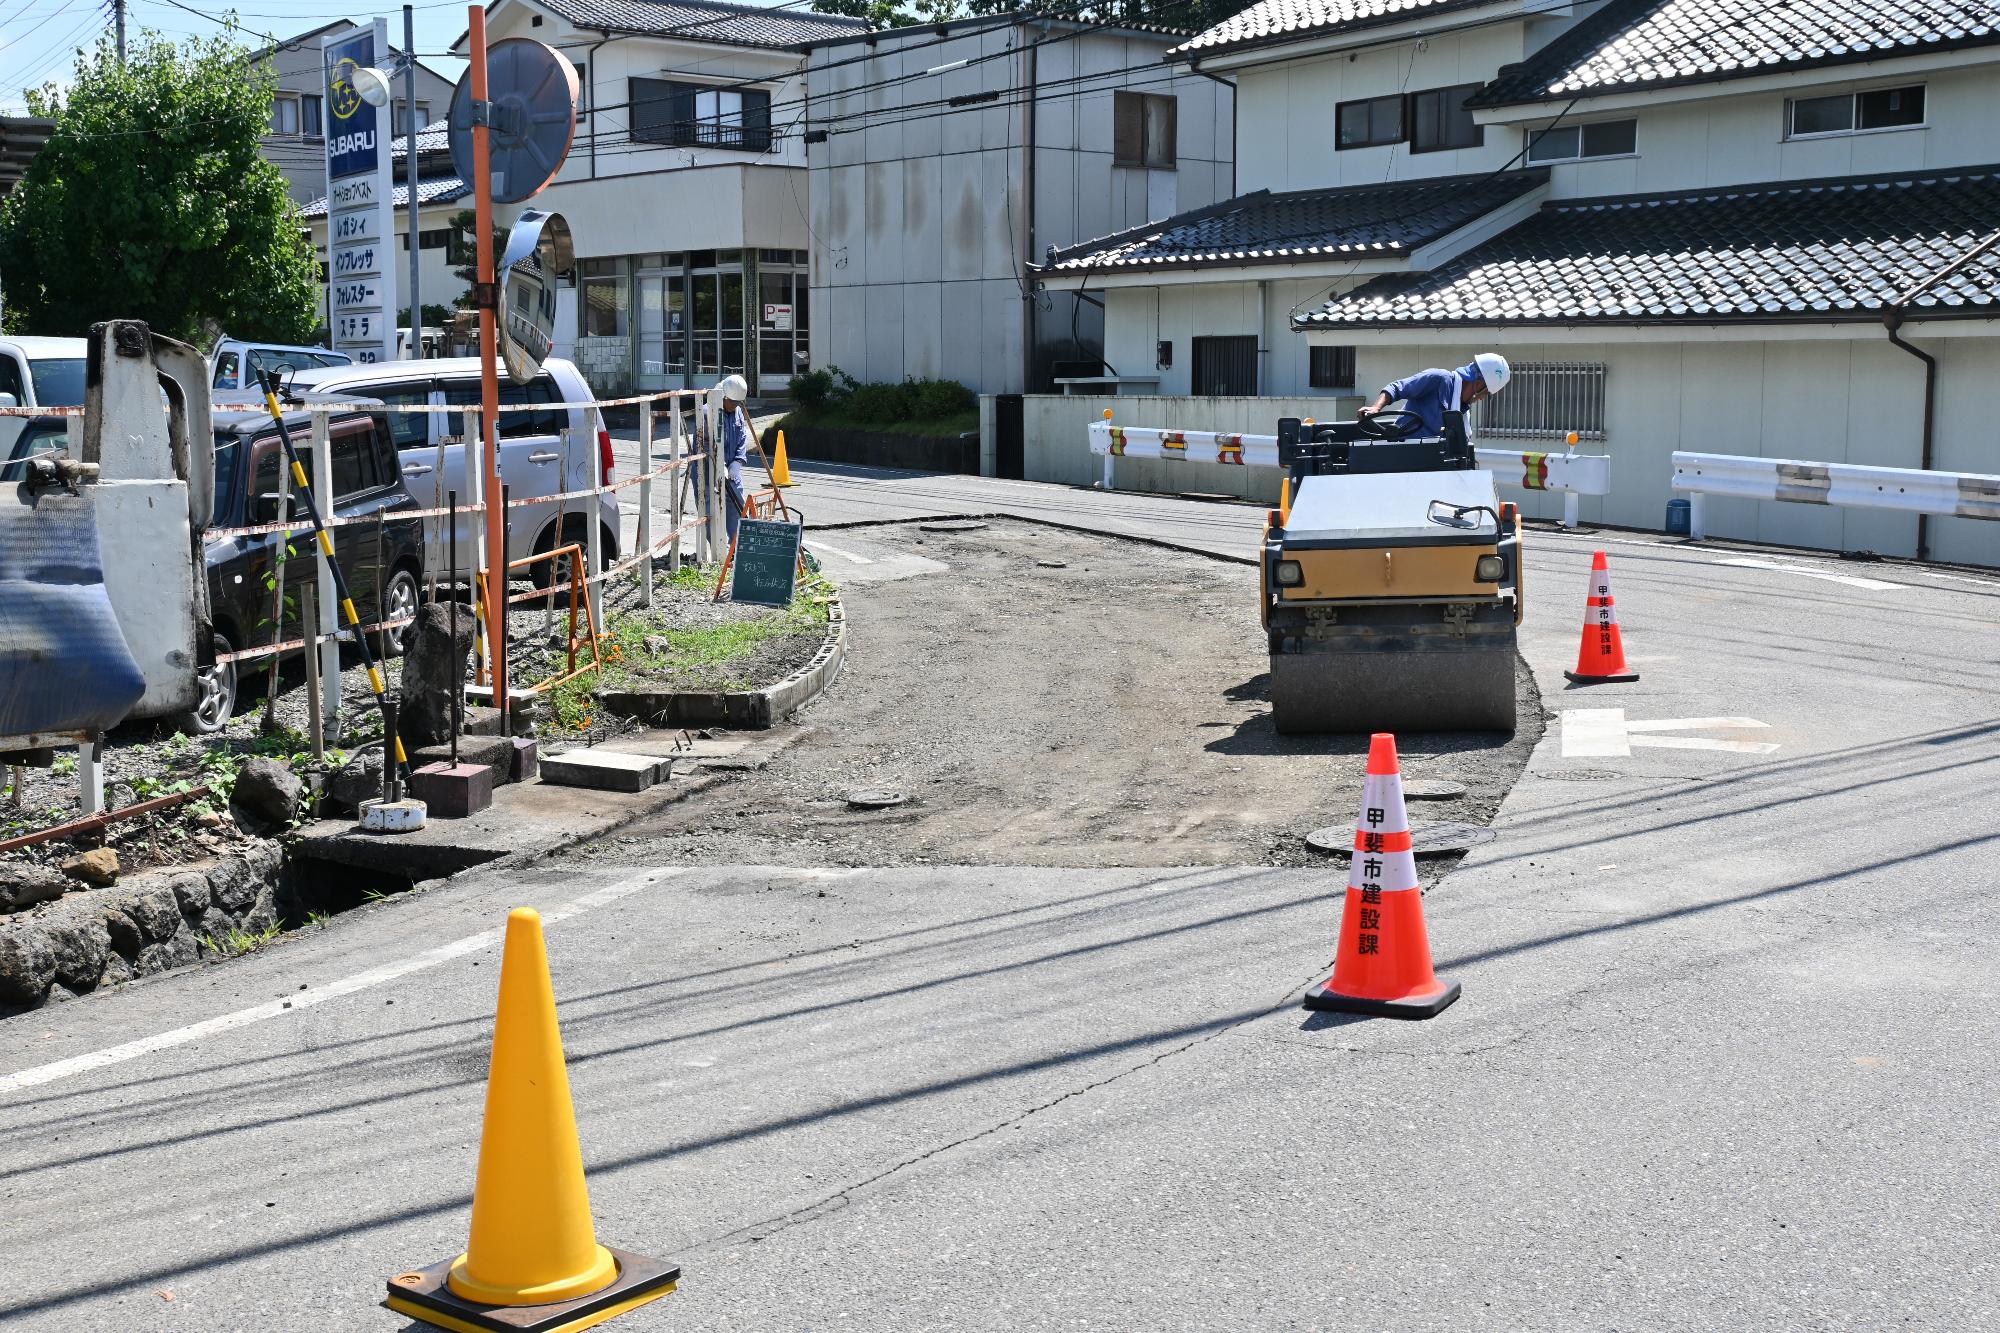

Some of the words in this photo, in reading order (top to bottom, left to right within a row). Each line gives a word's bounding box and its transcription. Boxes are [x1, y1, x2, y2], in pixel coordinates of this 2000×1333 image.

[329, 129, 375, 158] SUBARU
[336, 249, 374, 272] インプレッサ
[766, 305, 775, 320] P
[341, 317, 369, 338] ステラ
[1598, 585, 1612, 656] 甲斐市建設課
[1358, 807, 1385, 955] 甲斐市建設課
